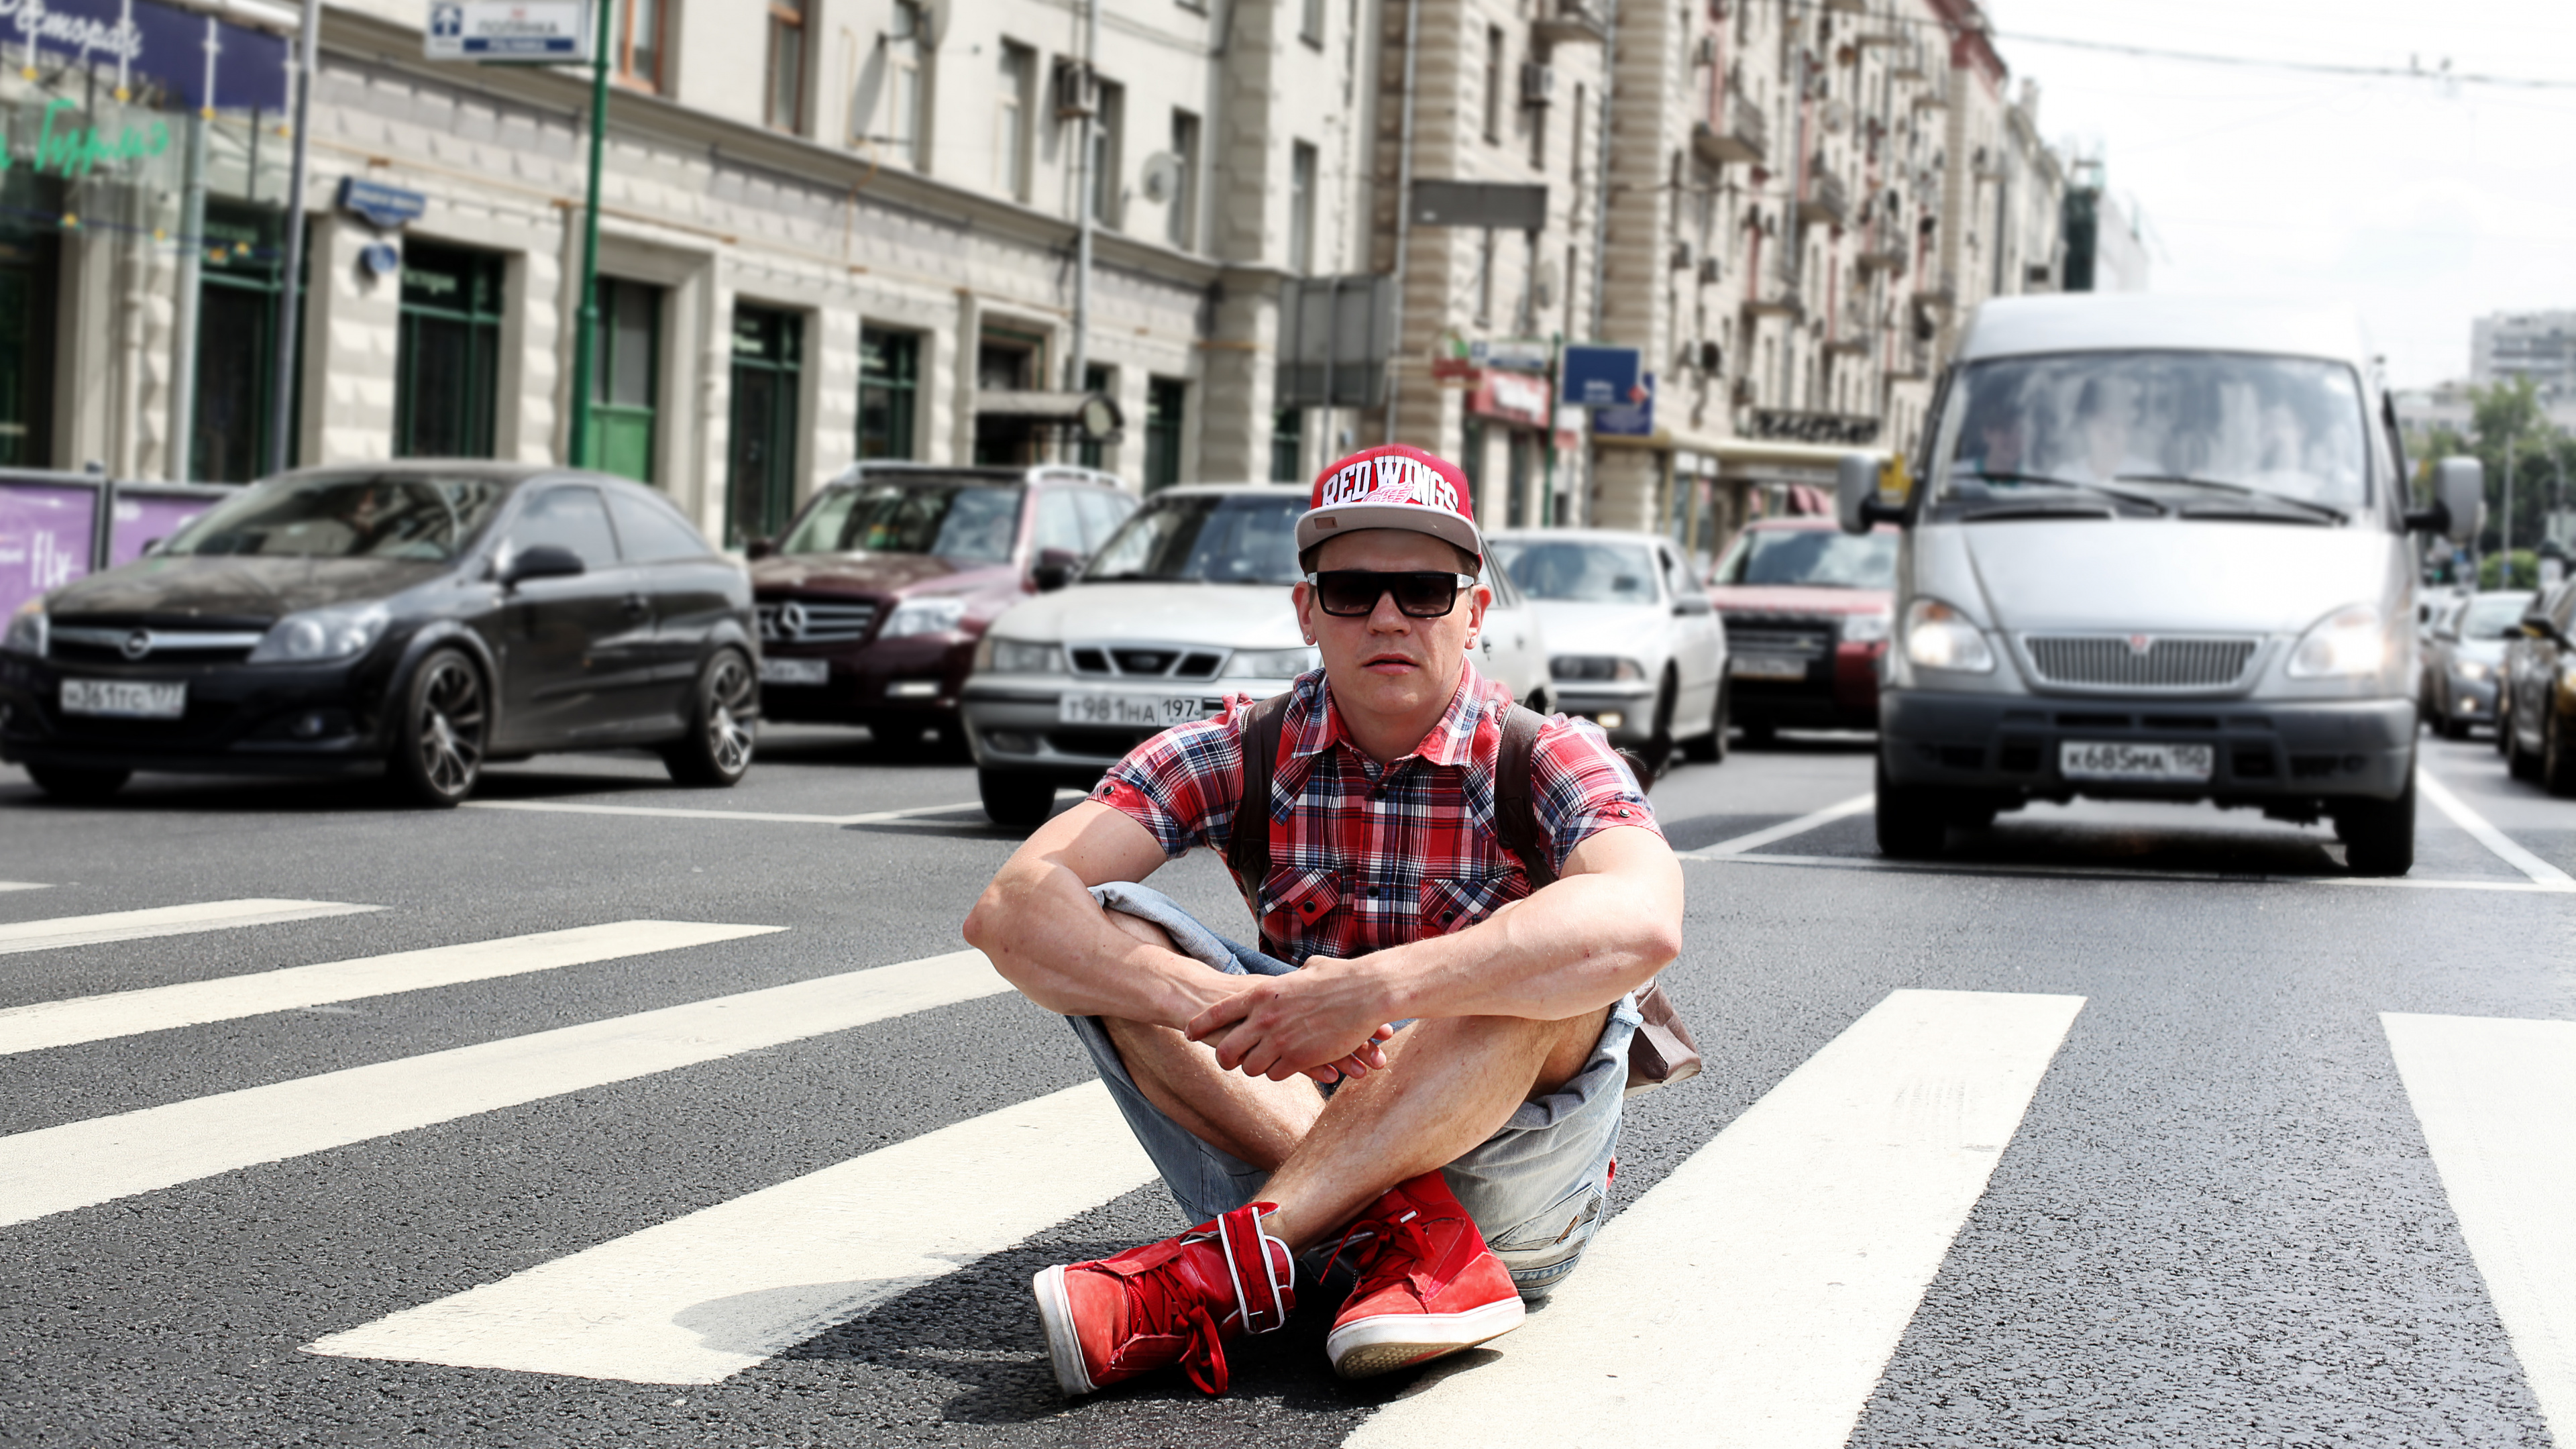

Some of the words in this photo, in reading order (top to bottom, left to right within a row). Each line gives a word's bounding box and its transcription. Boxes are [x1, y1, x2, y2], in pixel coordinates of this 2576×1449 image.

[1322, 460, 1372, 507] RED
[1373, 455, 1459, 514] WINGS
[1162, 699, 1195, 717] 197
